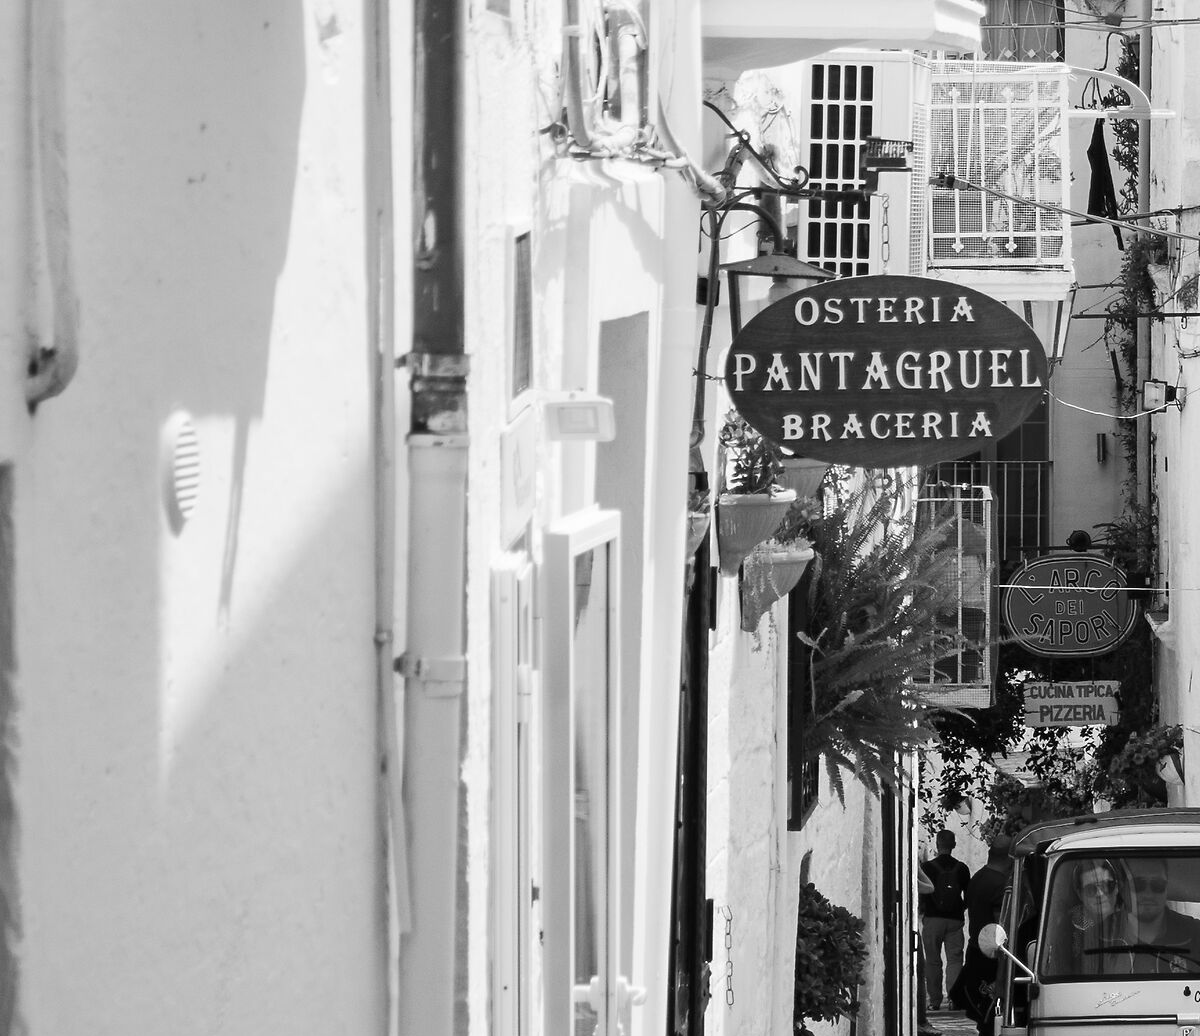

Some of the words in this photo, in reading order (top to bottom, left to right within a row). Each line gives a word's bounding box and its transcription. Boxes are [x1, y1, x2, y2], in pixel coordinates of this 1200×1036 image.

[794, 296, 975, 326] OSTERIA
[732, 348, 1042, 393] PANTAGRUEL
[781, 411, 994, 442] BRACERIA
[1055, 600, 1084, 615] DEI
[1023, 609, 1122, 645] SAPORI
[1030, 685, 1074, 699] CUCINA
[1076, 684, 1114, 698] TIPICA
[1039, 704, 1106, 722] PIZZERIA
